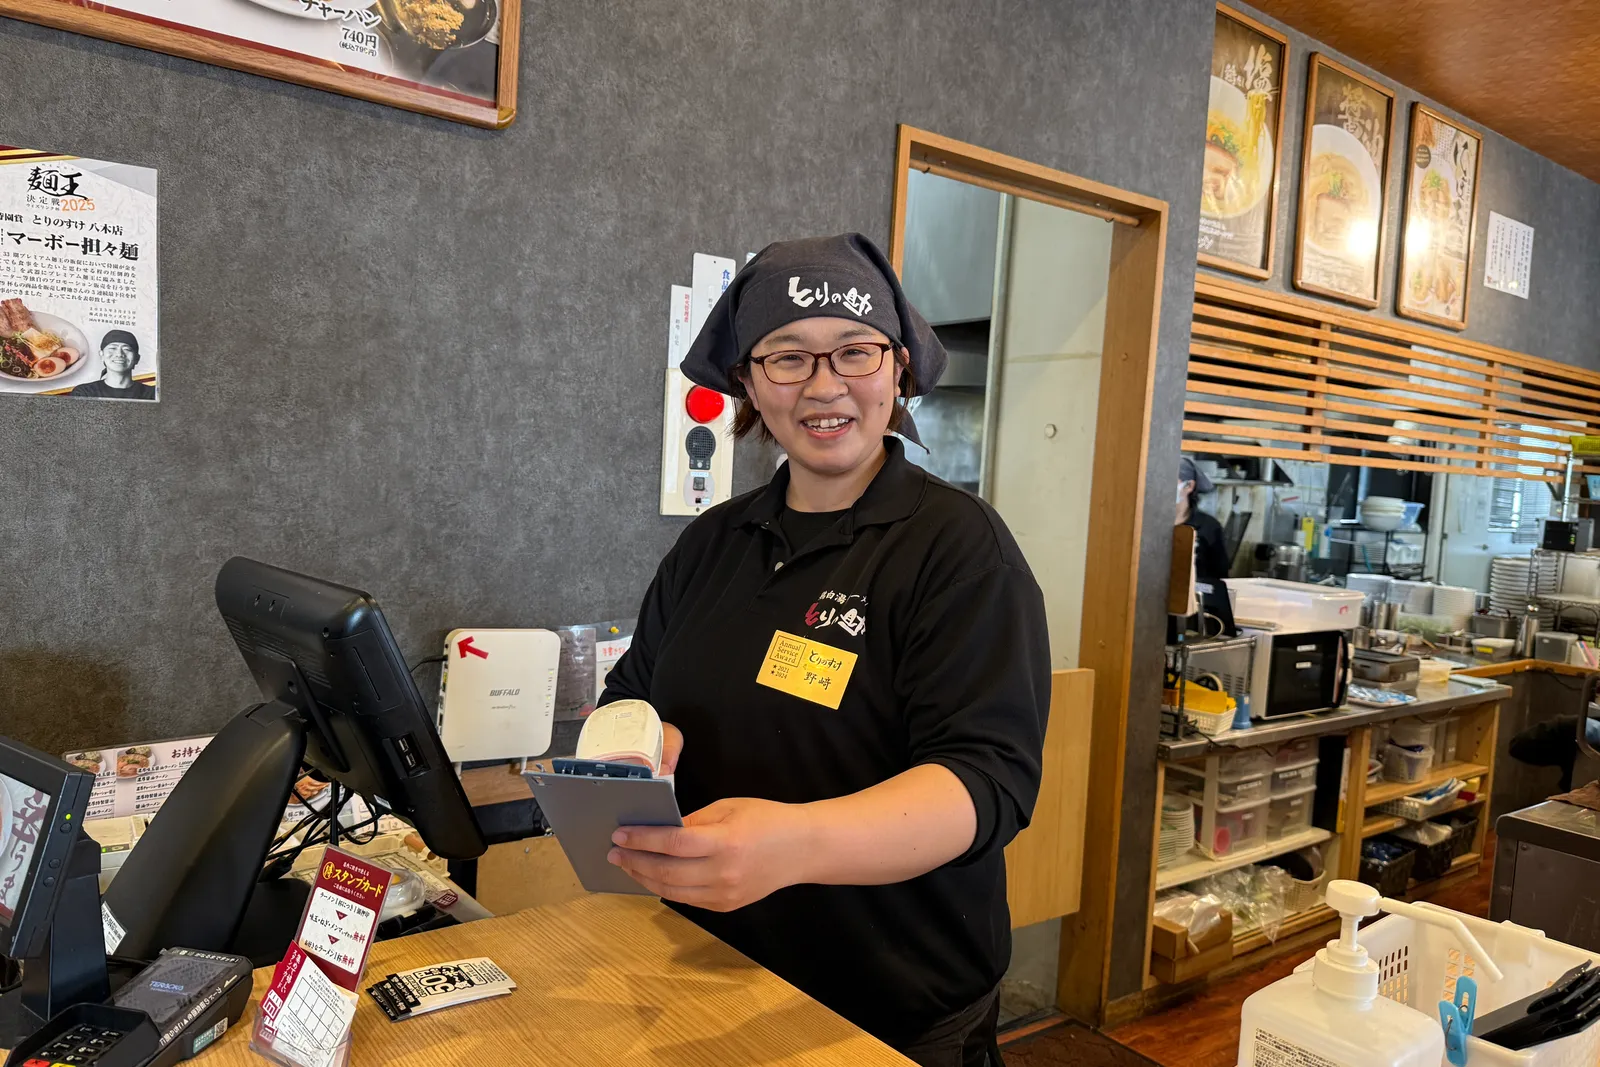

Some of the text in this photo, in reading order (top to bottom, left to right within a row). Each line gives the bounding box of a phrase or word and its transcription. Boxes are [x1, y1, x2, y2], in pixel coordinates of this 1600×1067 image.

[342, 27, 378, 49] 740円
[27, 165, 89, 201] 麺王
[26, 194, 96, 213] 決定戦 2025
[32, 214, 86, 231] とりのすけ
[88, 221, 124, 237] 八木店
[6, 231, 139, 261] マーボー担々麺
[777, 646, 799, 658] Service
[779, 640, 802, 652] Annual
[774, 652, 797, 664] Award
[809, 650, 843, 671] とりのすけ
[489, 688, 521, 697] BUFFALO
